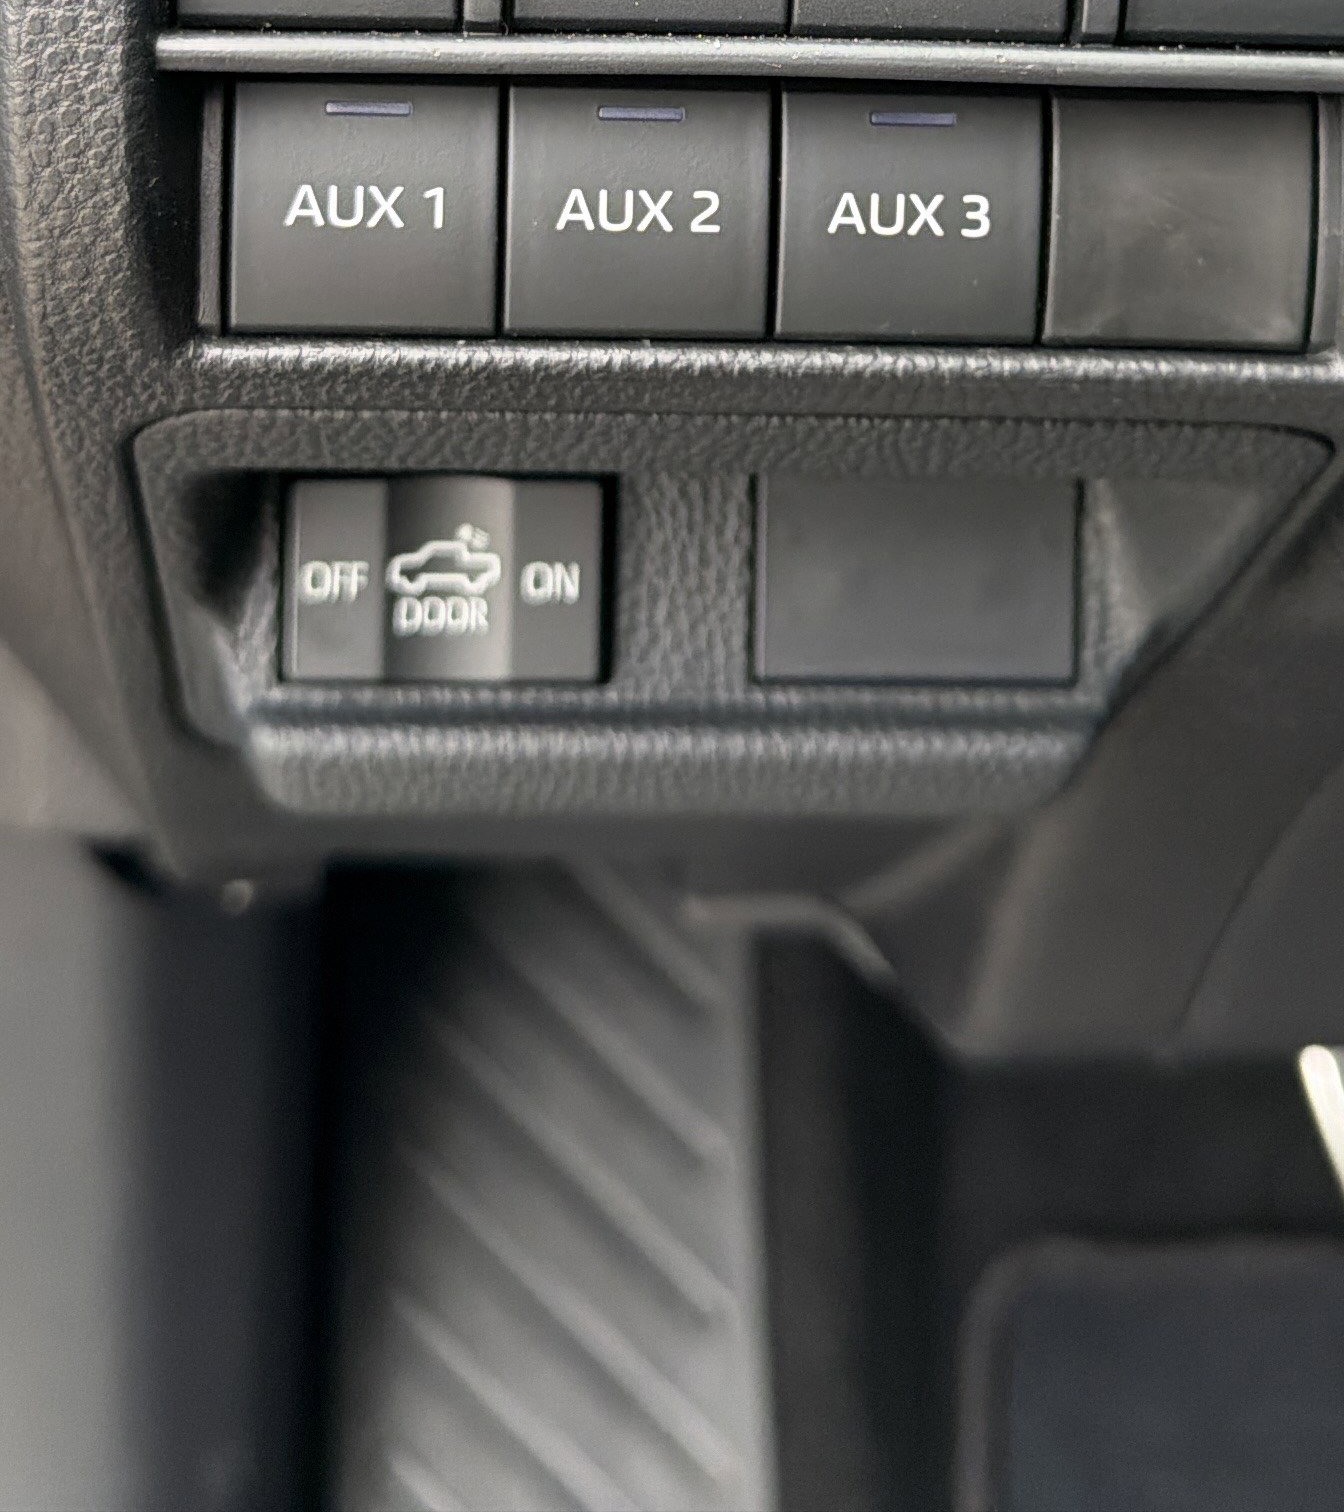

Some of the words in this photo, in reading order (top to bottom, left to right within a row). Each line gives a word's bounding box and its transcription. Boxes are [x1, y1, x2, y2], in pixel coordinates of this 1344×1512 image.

[283, 183, 406, 230] AUX
[421, 185, 447, 230] 1
[554, 187, 675, 234] AUX
[689, 189, 722, 235] 2
[826, 191, 946, 238] AUX
[959, 193, 992, 239] 3
[300, 560, 369, 603] OFF
[520, 561, 580, 605] ON
[393, 595, 489, 636] DOOR
